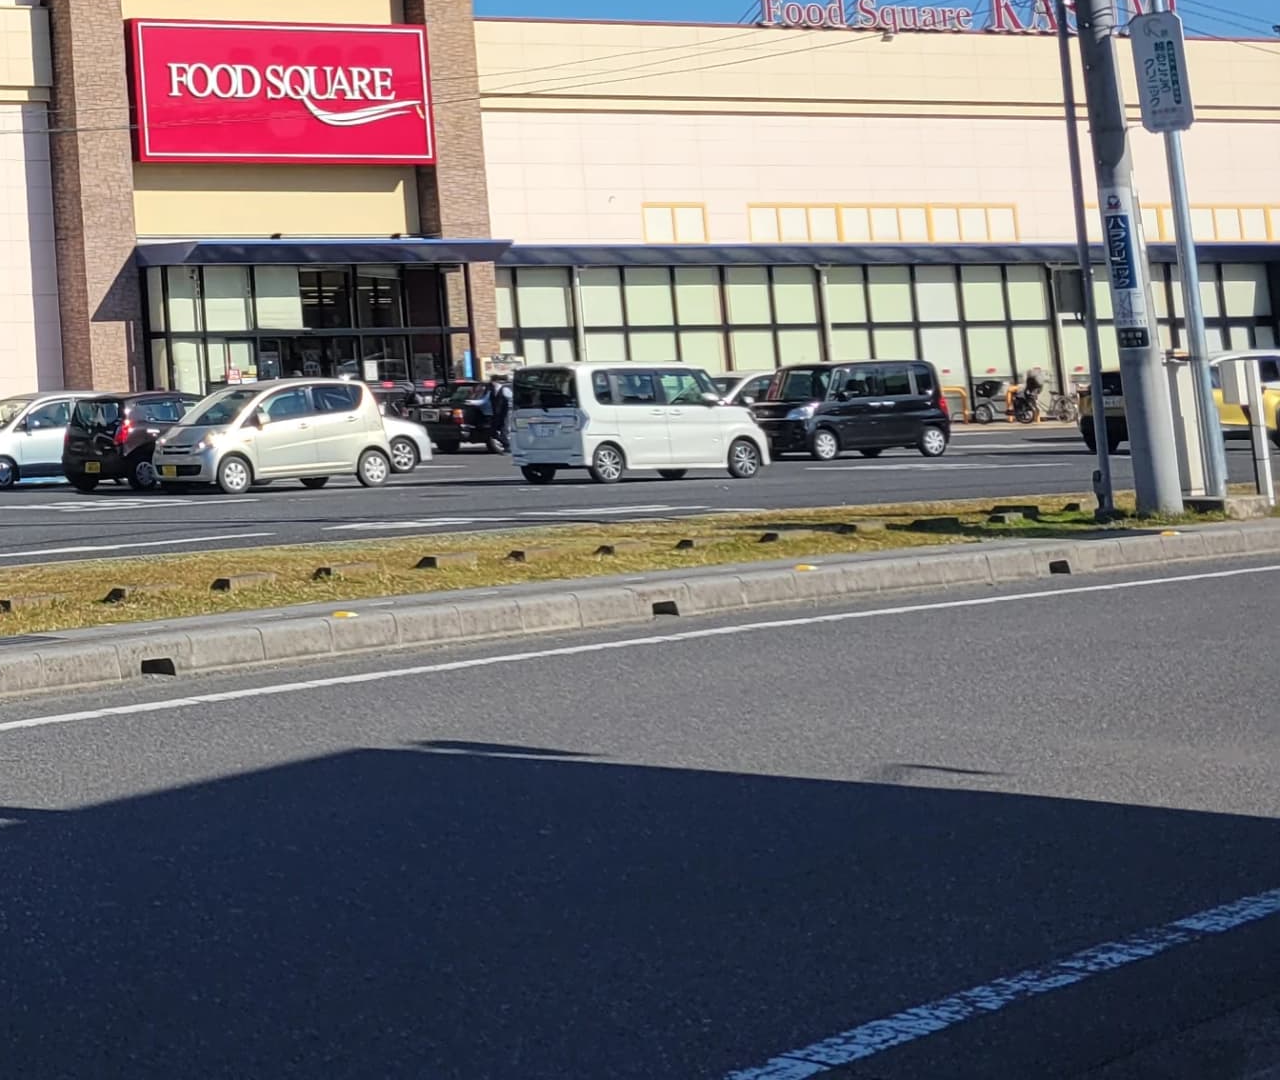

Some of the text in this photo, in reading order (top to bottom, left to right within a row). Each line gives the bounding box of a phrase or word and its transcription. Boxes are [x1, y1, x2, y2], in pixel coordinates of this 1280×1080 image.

[167, 63, 396, 104] FOOD SQUARE
[1144, 58, 1160, 108] クリニック
